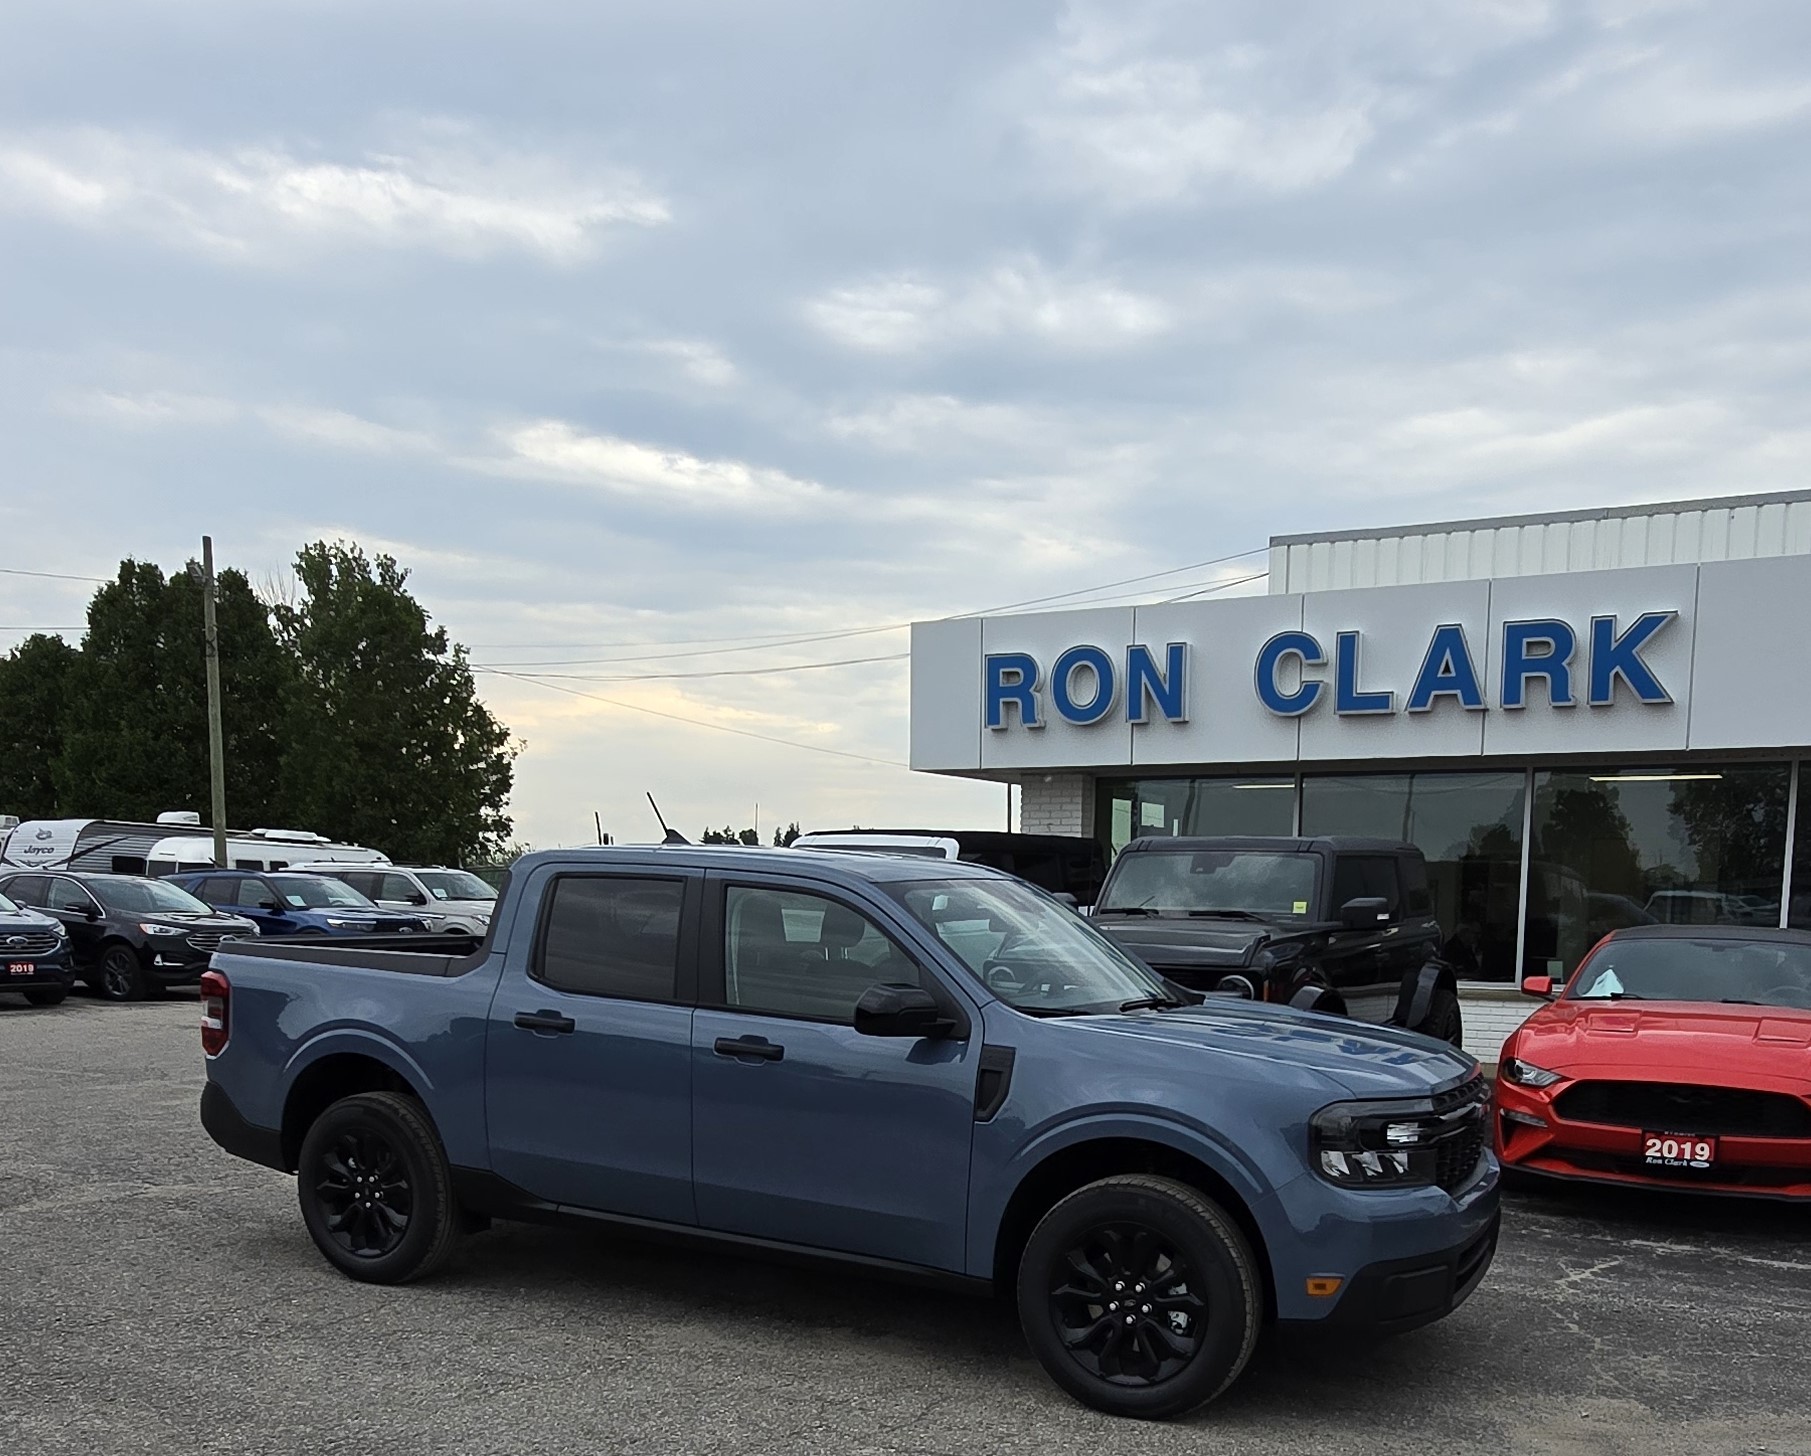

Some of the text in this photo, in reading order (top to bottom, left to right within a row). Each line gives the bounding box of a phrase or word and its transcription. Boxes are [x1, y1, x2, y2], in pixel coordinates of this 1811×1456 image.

[985, 611, 1679, 730] RON CLARK
[23, 845, 55, 856] Jayco
[1645, 1138, 1710, 1161] 2019
[1664, 1158, 1688, 1166] Clark
